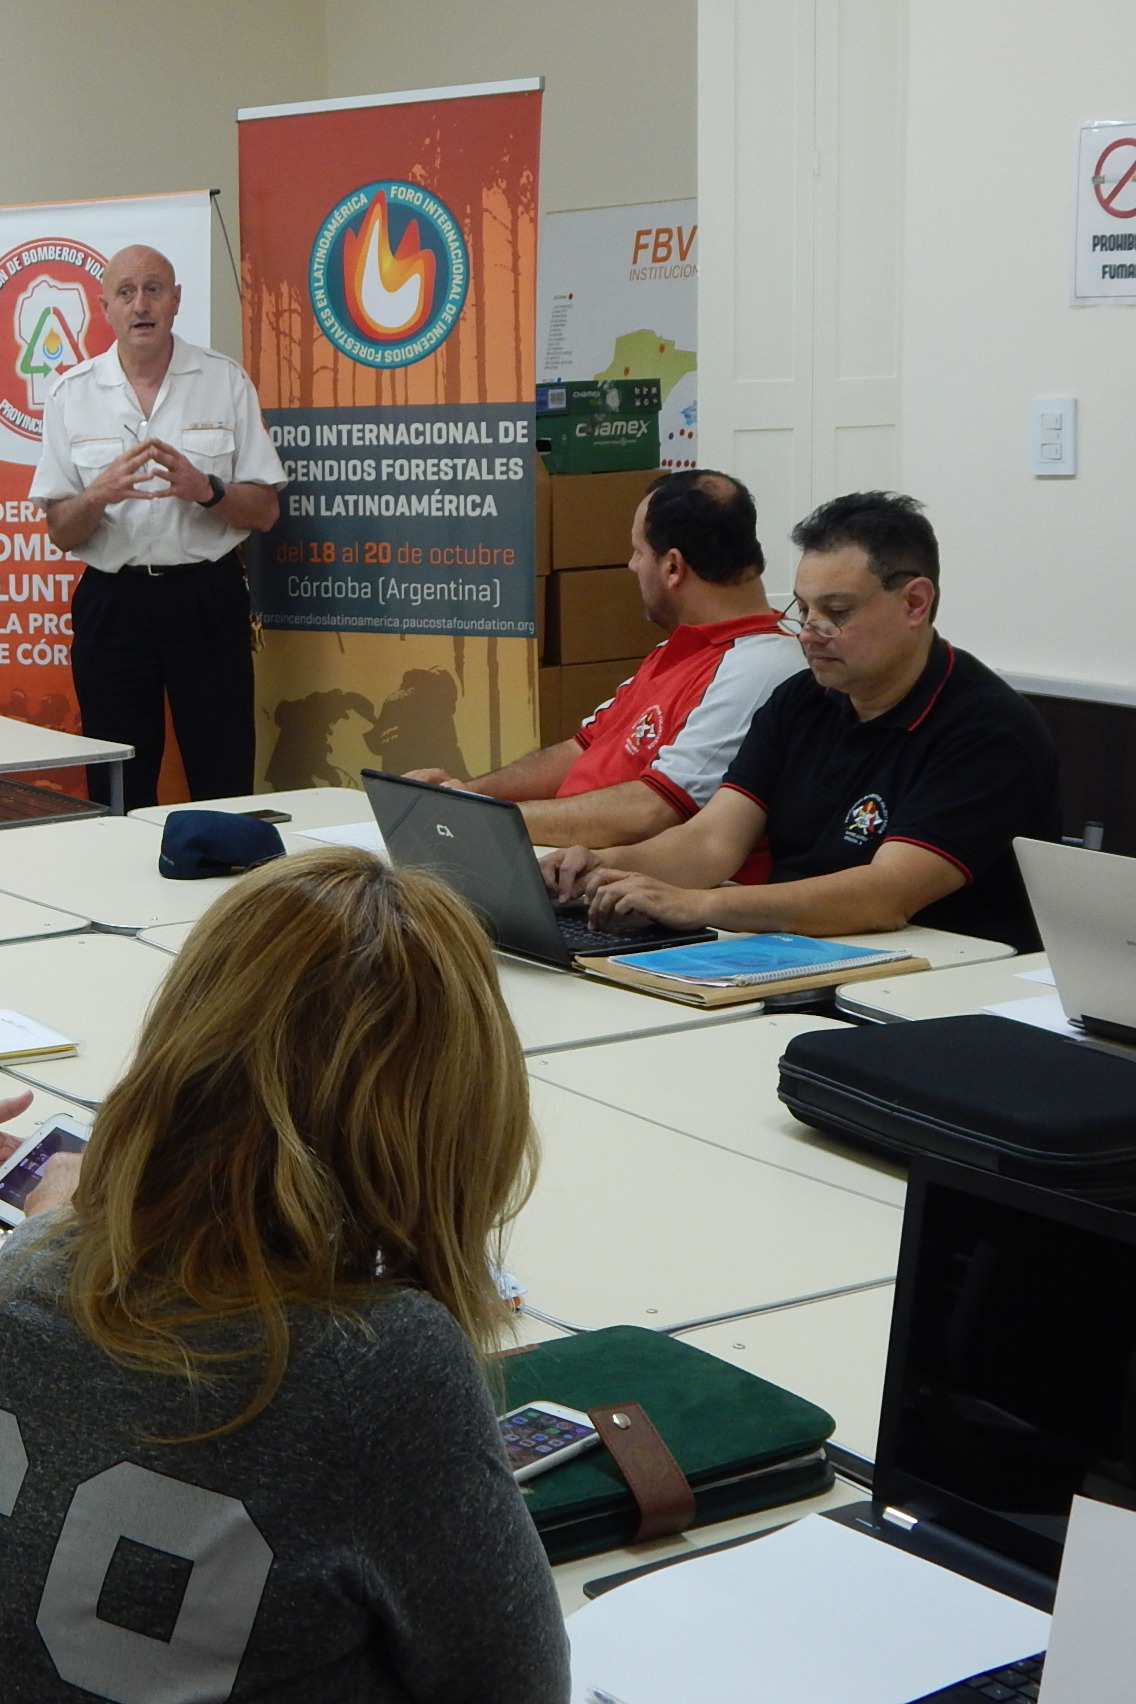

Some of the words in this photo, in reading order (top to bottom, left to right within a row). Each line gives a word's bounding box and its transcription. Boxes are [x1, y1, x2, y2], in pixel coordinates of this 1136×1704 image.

[390, 185, 423, 205] FORO
[313, 193, 369, 287] LATINOAMÉRICA
[423, 198, 464, 301] INTERNACIONAL
[632, 225, 698, 265] FBV
[6, 256, 22, 274] DE
[21, 245, 84, 266] BOMBEROS
[85, 257, 104, 284] VOL
[315, 289, 328, 308] EN
[441, 303, 457, 323] DE
[320, 308, 382, 362] FORESTALES
[384, 324, 447, 362] INCENDIOS
[316, 421, 493, 446] INTERNACIONAL
[498, 420, 529, 444] DE
[381, 458, 524, 481] FORESTALES
[289, 495, 314, 516] EN
[320, 489, 498, 517] LATINOAMÉRICA
[276, 541, 304, 563] del
[308, 542, 336, 563] 18
[341, 541, 359, 563] al
[364, 541, 392, 564] 20
[397, 543, 422, 564] de
[429, 543, 515, 566] octubre
[288, 575, 372, 598] Córdoba
[16, 638, 71, 666] CÓR
